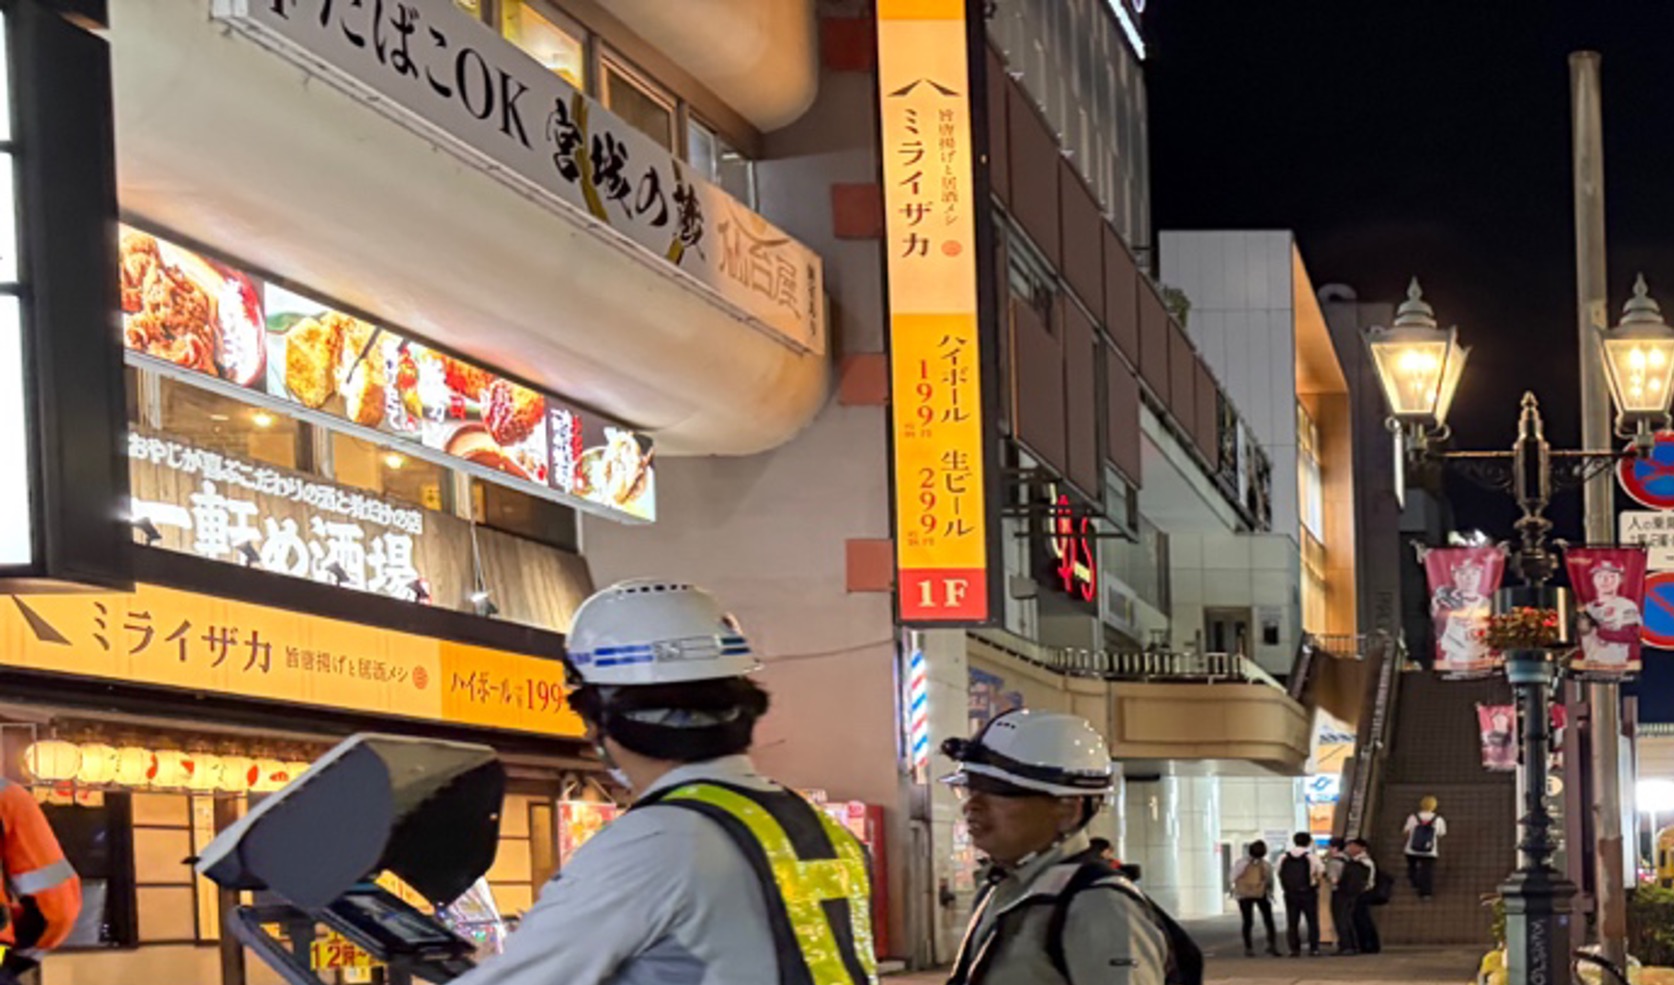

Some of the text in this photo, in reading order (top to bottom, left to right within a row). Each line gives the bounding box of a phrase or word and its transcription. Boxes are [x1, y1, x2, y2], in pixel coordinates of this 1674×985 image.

[898, 109, 933, 258] ミライザカ
[937, 334, 970, 423] ハイボール
[941, 450, 974, 537] 生ビール
[131, 480, 421, 603] 一軒め酒場
[917, 579, 968, 608] 1F
[92, 600, 272, 675] ミライザカ
[451, 672, 512, 704] ハイボール
